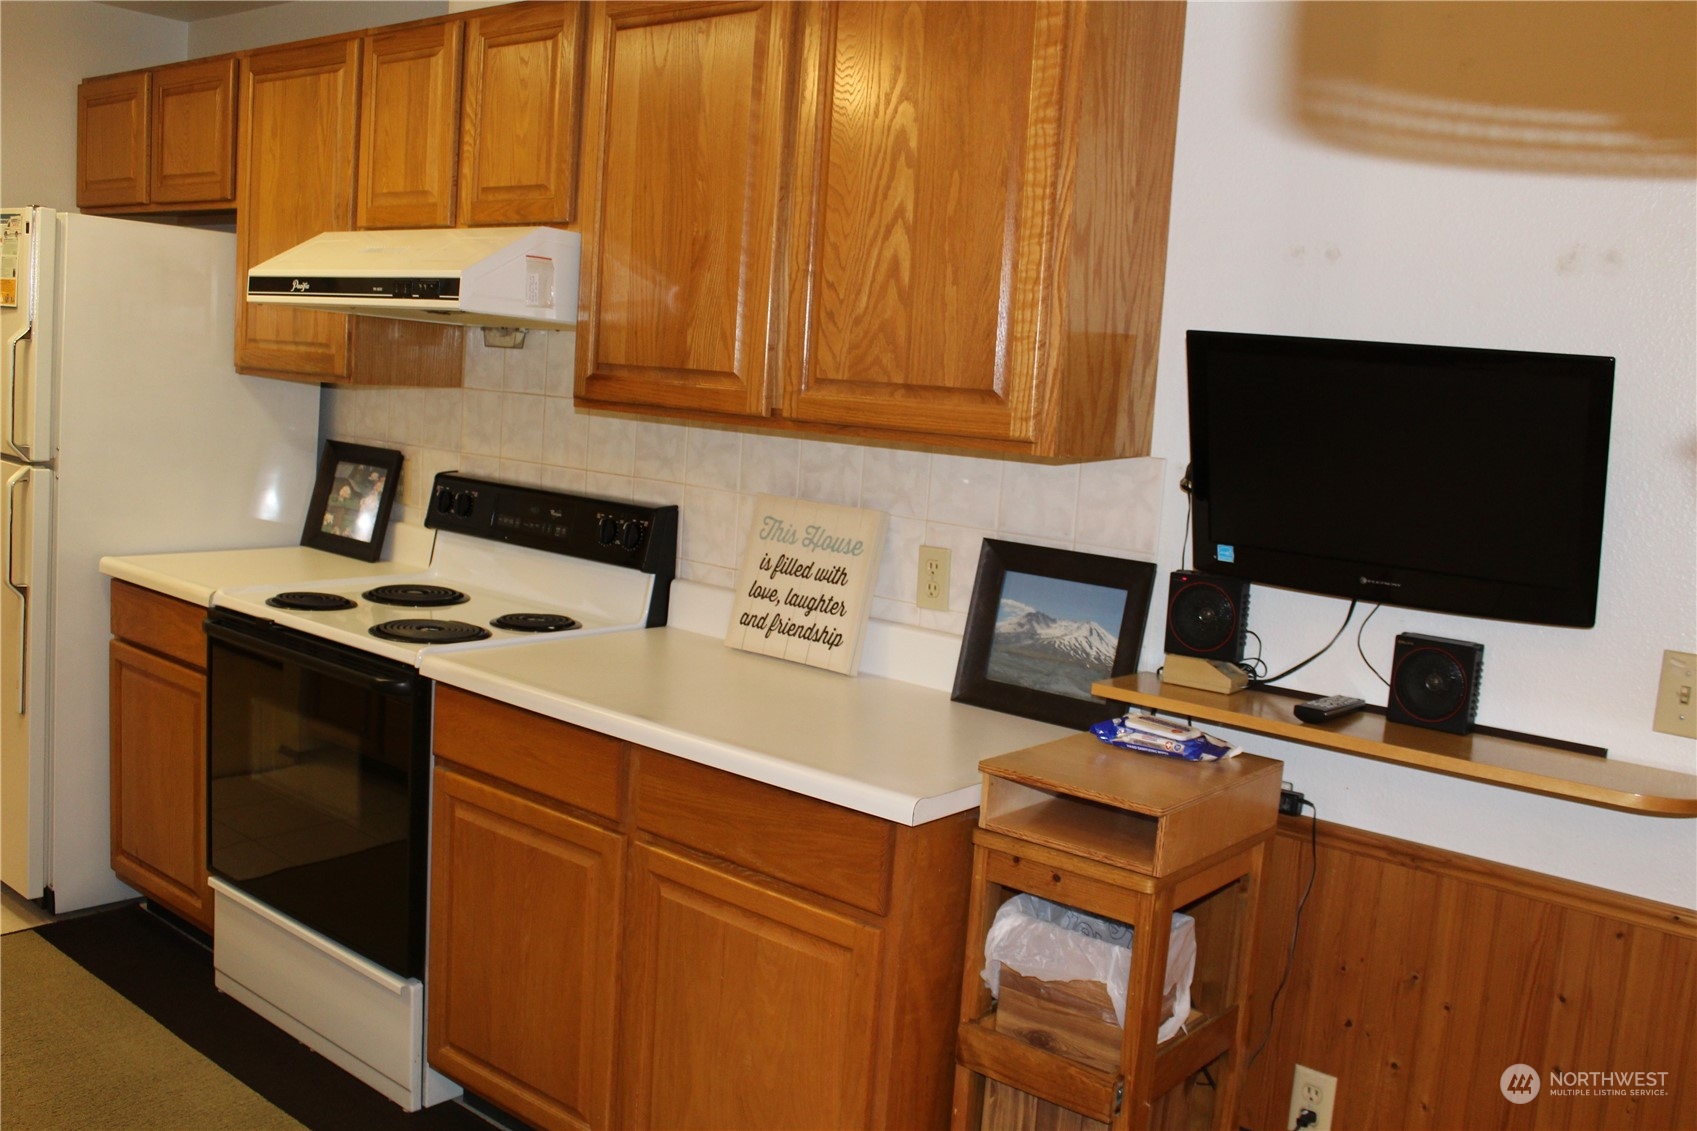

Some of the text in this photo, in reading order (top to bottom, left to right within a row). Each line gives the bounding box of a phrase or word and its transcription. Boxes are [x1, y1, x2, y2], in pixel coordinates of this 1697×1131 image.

[759, 515, 864, 556] This House
[759, 553, 848, 586] is filled with
[748, 580, 847, 617] love, laughter
[739, 611, 844, 650] and friendship
